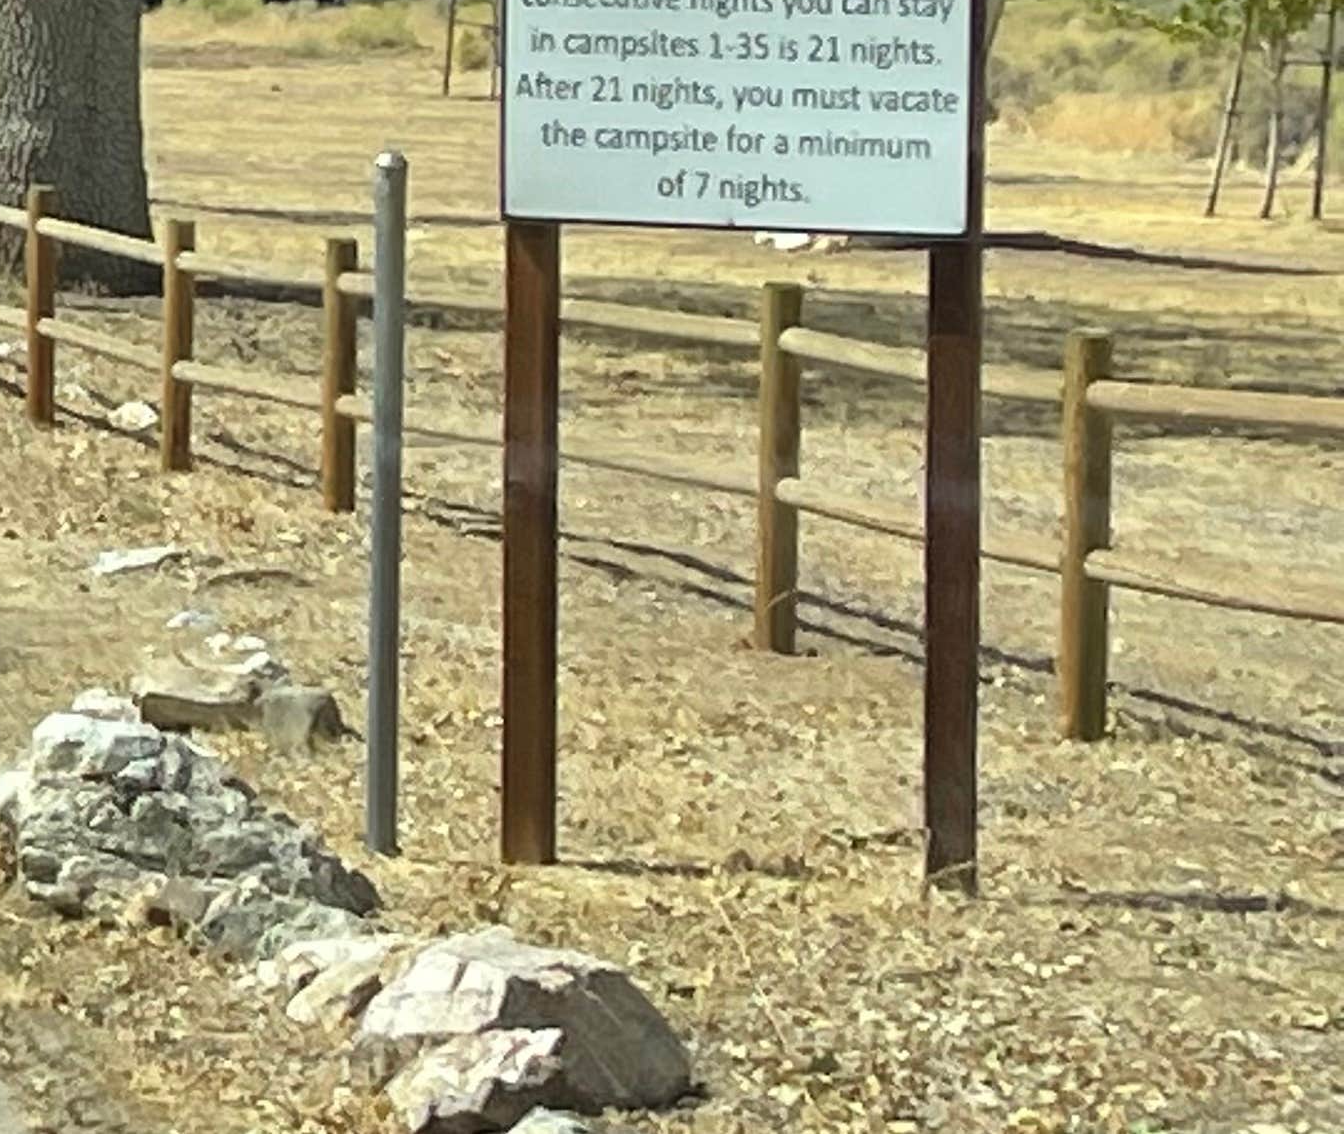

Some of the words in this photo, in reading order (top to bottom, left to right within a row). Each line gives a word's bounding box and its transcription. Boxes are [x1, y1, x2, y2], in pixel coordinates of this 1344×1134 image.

[529, 28, 556, 53] in
[563, 28, 699, 62] campsites
[710, 32, 771, 61] 1-35
[777, 34, 799, 61] is
[805, 34, 840, 63] 21
[850, 36, 944, 70] nights.
[514, 70, 584, 102] After
[589, 74, 623, 103] 21
[632, 75, 725, 114] nights,
[731, 85, 783, 114] you
[792, 86, 861, 111] must
[868, 88, 960, 114] vacate
[541, 118, 587, 148] the
[593, 120, 718, 157] campsite
[726, 123, 766, 154] for
[773, 134, 790, 155] a
[797, 130, 931, 160] minimum
[657, 168, 687, 199] of
[693, 171, 710, 199] 7
[718, 171, 811, 209] nights.
